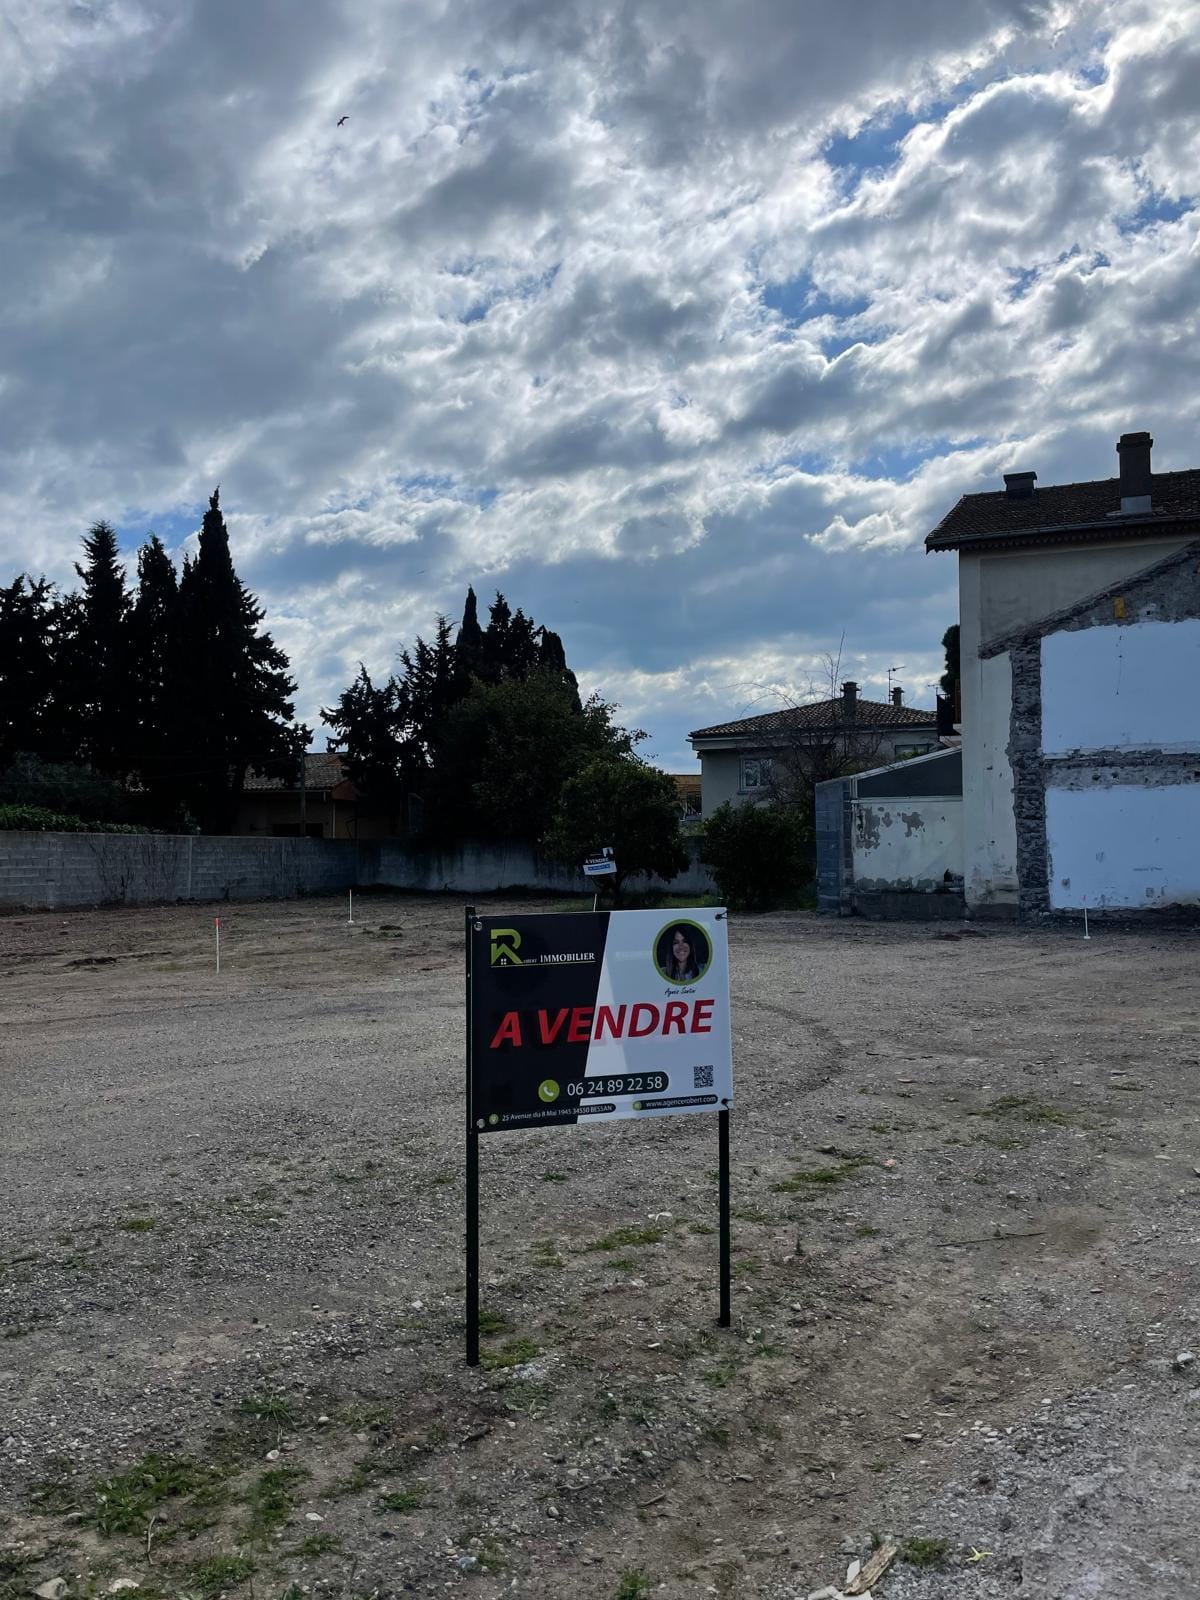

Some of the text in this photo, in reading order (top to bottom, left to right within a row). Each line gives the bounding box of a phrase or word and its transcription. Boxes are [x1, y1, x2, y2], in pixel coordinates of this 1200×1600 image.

[540, 952, 595, 963] IMMOBILIER
[489, 999, 715, 1049] A VENDRE
[567, 1076, 663, 1097] 06 24 89 22 58
[645, 1095, 717, 1108] www.agencerobert.com
[502, 1114, 510, 1122] 25
[510, 1113, 532, 1121] Avenue
[546, 1109, 558, 1117] Mai
[590, 1104, 613, 1113] BESSAN
